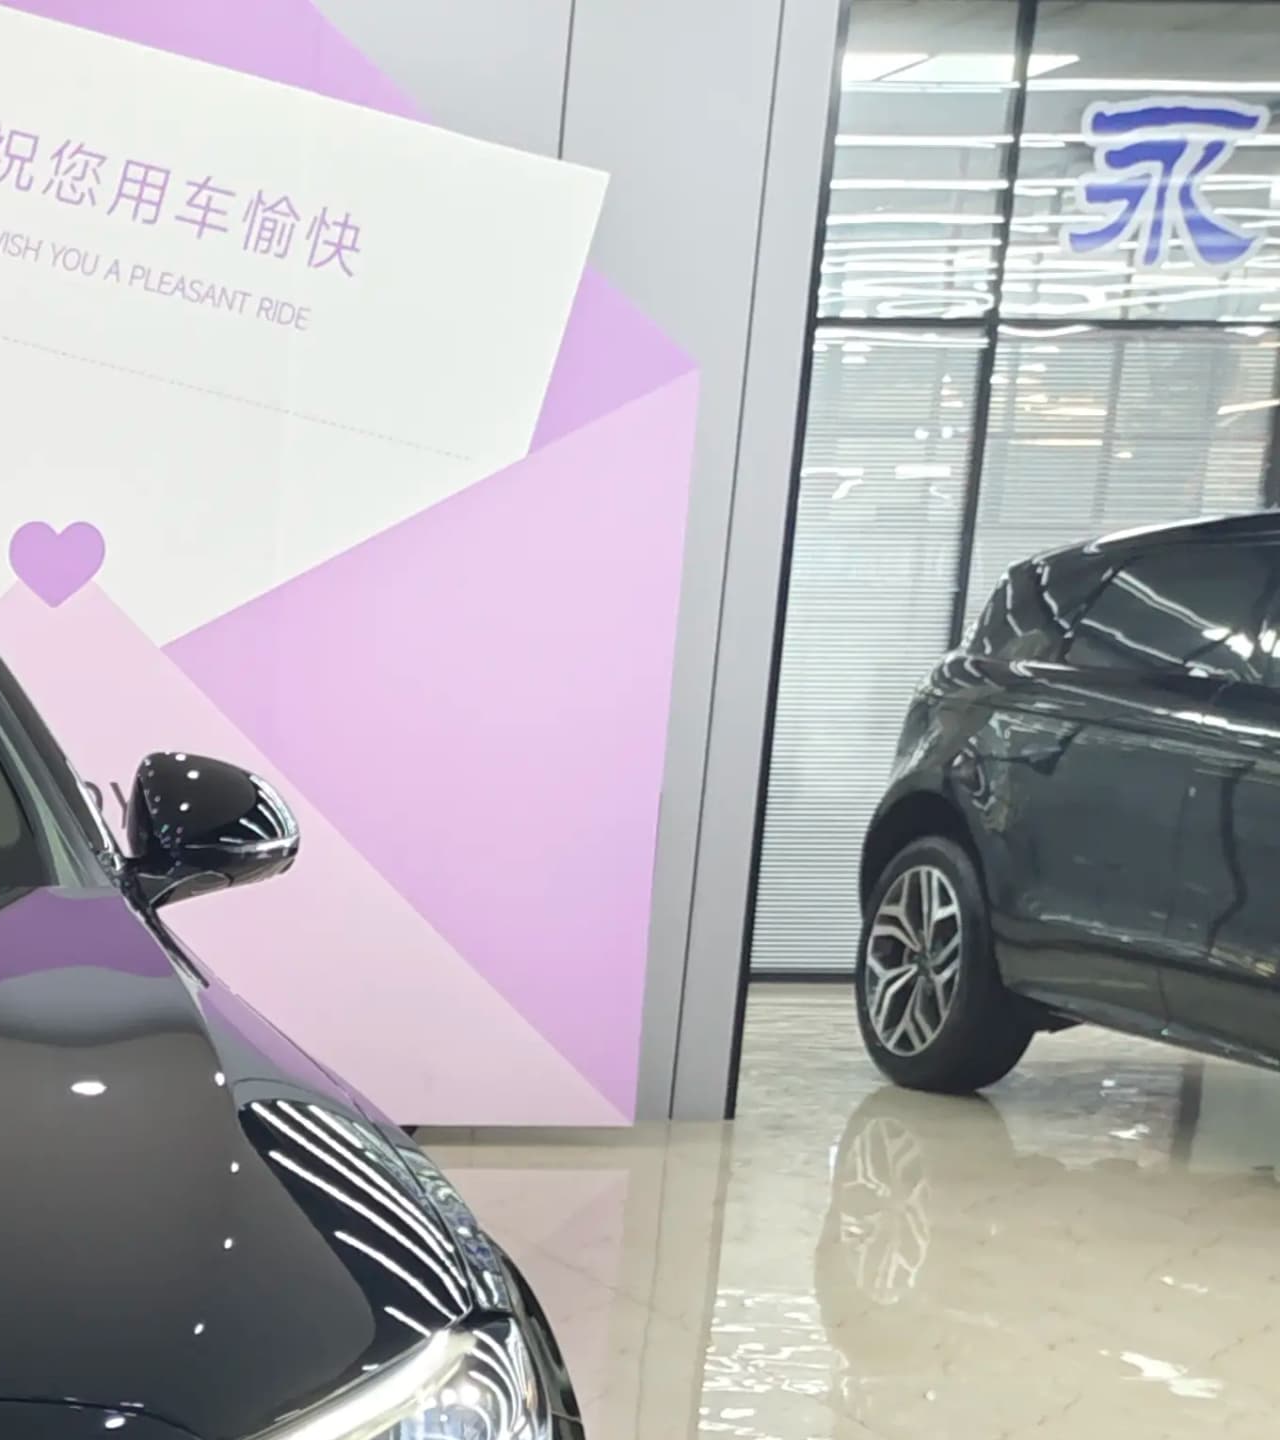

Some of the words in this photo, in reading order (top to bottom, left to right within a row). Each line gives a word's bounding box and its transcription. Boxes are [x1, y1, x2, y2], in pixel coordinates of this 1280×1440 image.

[51, 242, 100, 276] YOU
[103, 259, 121, 283] A
[128, 264, 252, 315] PLEASANT
[256, 296, 312, 331] RIDE
